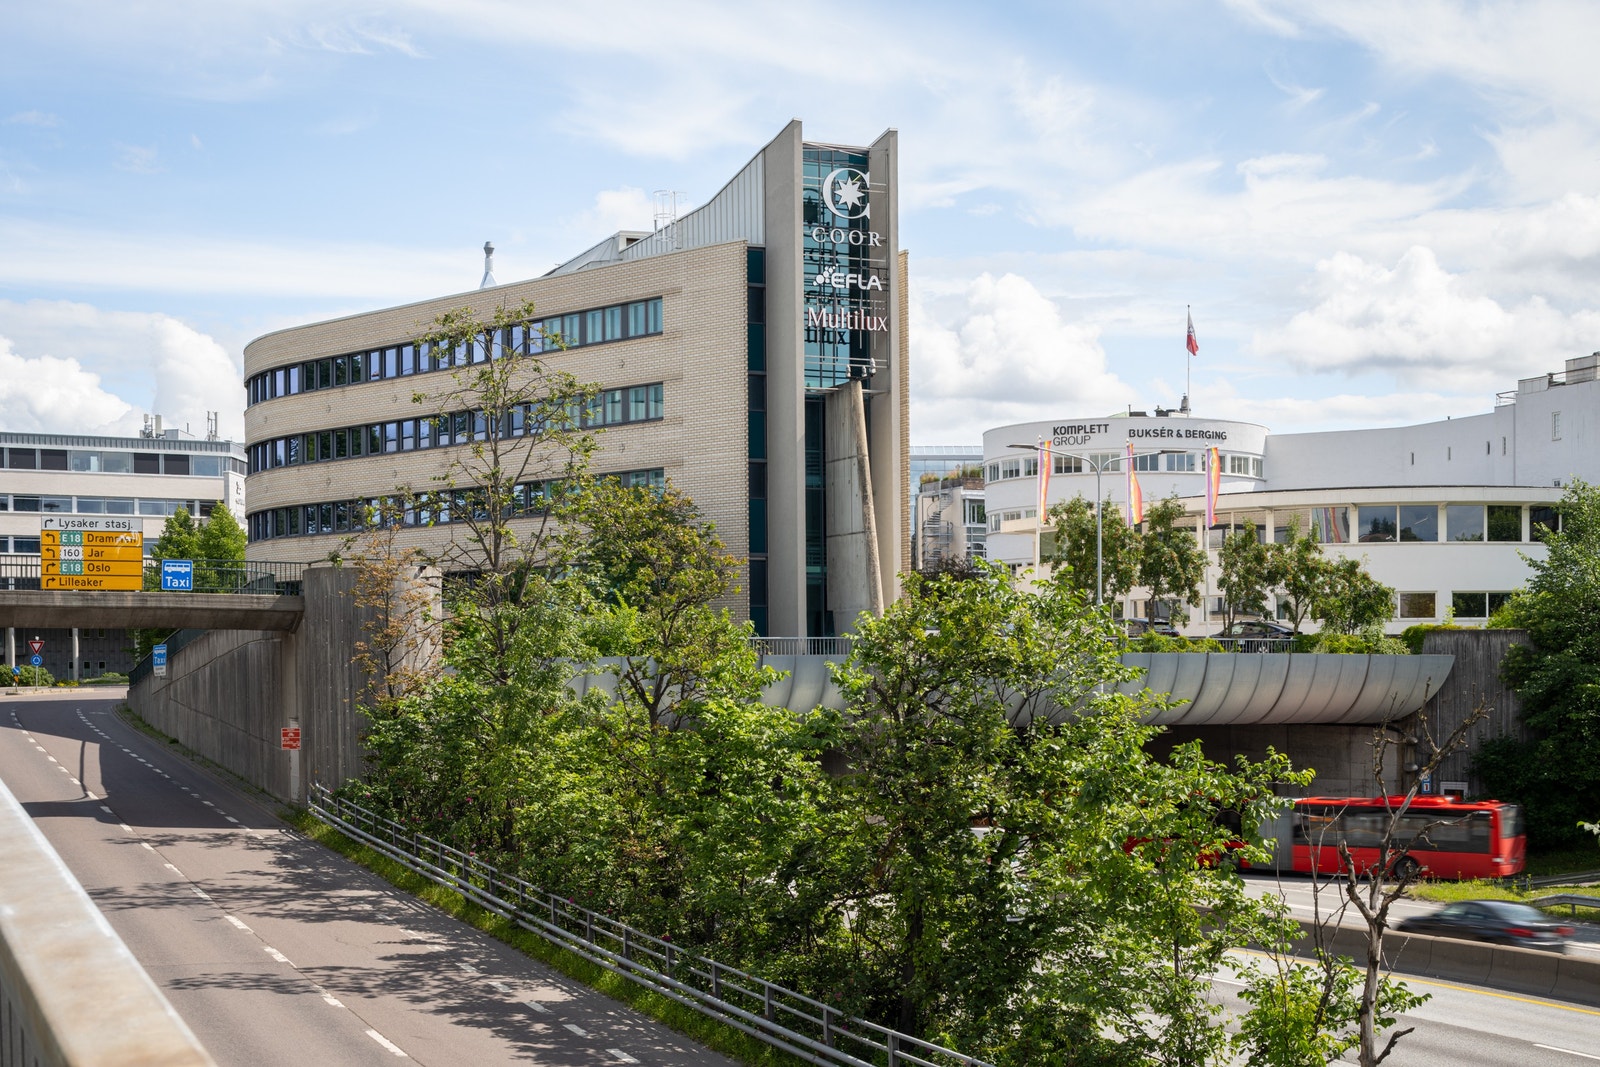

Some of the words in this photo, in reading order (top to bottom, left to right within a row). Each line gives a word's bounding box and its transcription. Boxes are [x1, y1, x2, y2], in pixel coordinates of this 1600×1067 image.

[812, 227, 882, 247] COOR
[831, 273, 883, 291] EFLA
[807, 306, 888, 332] Multilux
[1053, 424, 1109, 436] KOMPLETT
[1129, 426, 1174, 438] BUKSÉR
[1176, 430, 1183, 438] &
[1185, 429, 1227, 440] BERGING
[1053, 435, 1091, 446] GROUP
[58, 518, 99, 530] Lysaker
[105, 519, 133, 531] stasj.
[63, 549, 80, 557] 160
[88, 548, 104, 558] Jar
[87, 563, 111, 572] Oslo
[59, 577, 103, 587] Lilleaker
[165, 576, 190, 588] Taxi
